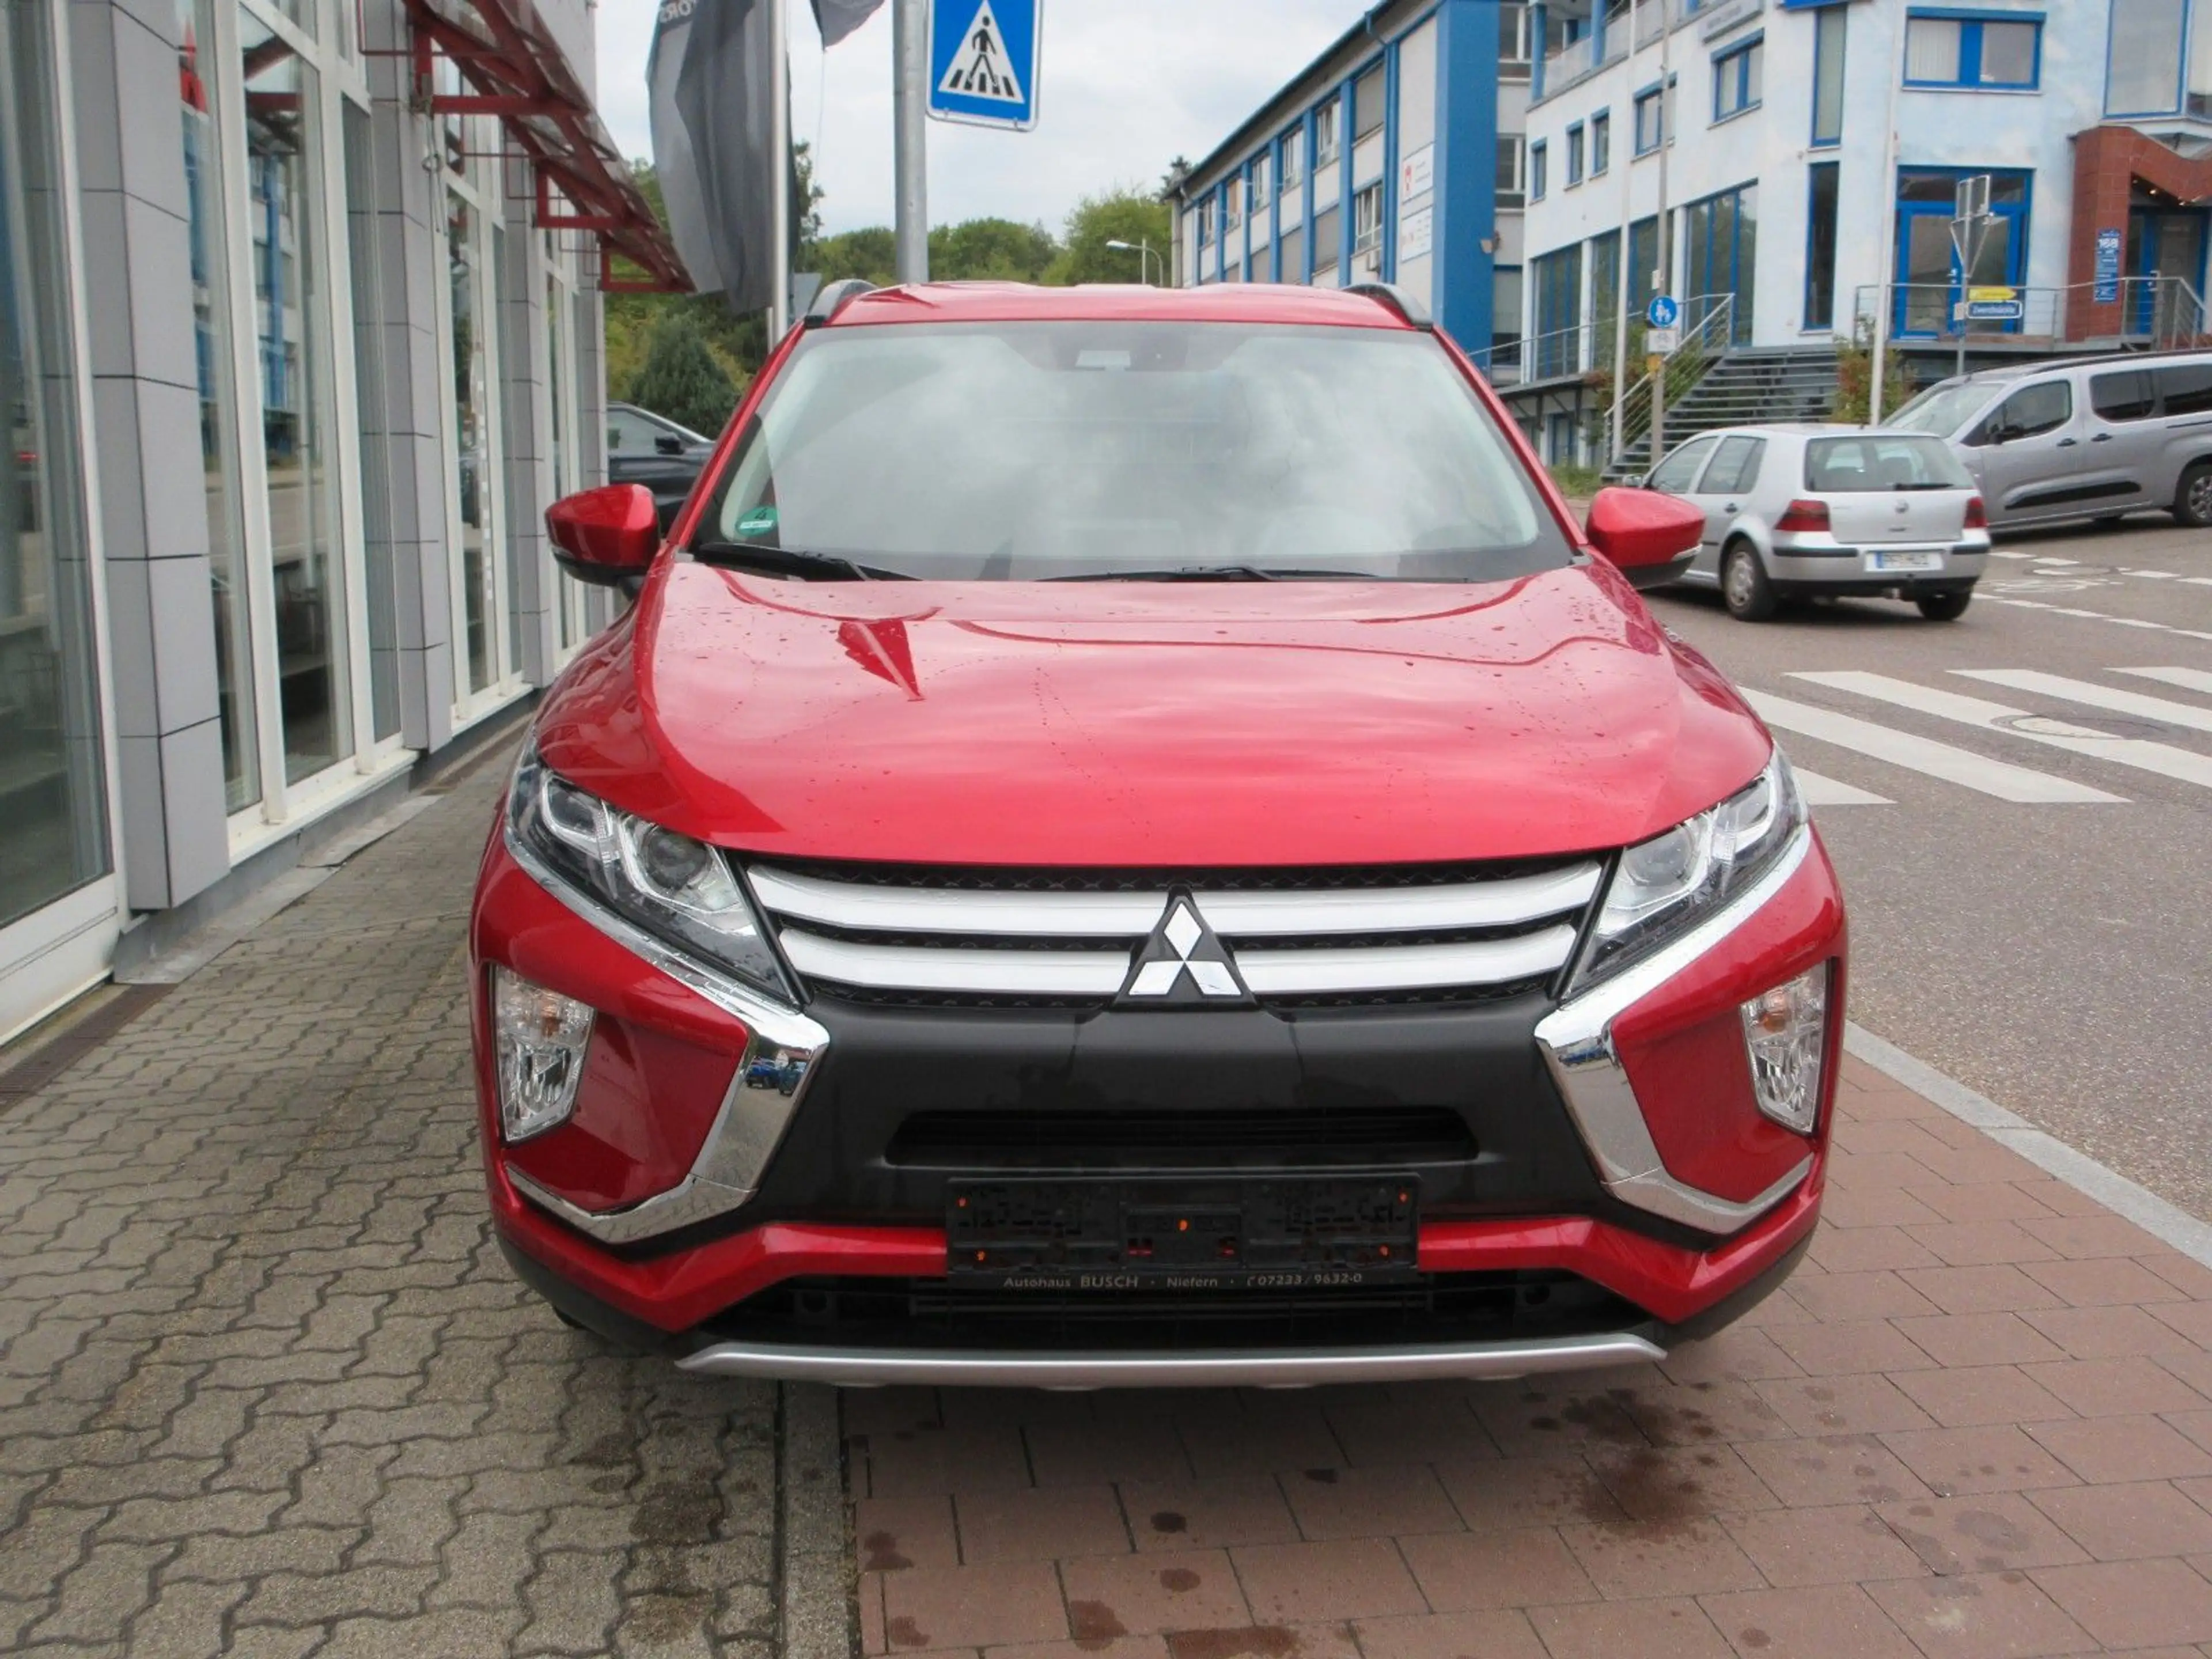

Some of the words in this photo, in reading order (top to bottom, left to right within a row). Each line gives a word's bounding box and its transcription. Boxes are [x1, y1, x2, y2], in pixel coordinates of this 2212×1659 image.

[754, 507, 768, 520] 4
[1003, 1276, 1071, 1288] Autohaus
[1080, 1275, 1139, 1288] BUSCH
[1166, 1276, 1218, 1288] Niefern
